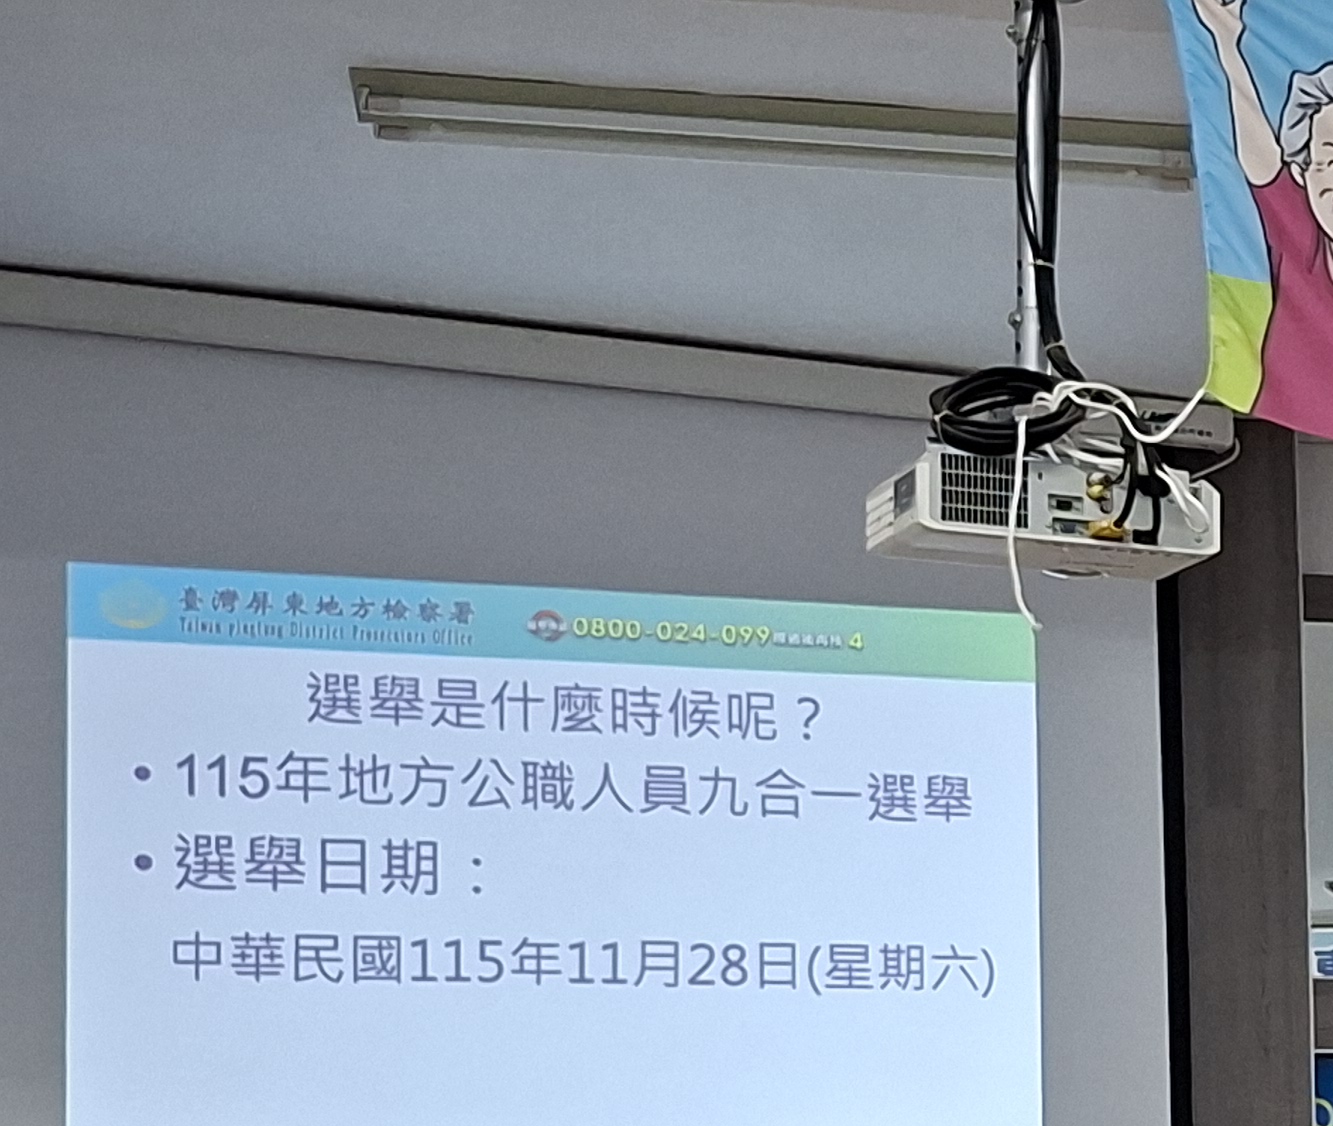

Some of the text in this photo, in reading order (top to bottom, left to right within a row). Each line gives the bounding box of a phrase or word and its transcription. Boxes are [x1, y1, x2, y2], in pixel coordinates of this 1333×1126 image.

[179, 586, 476, 625] 臺灣屏東地方檢察署
[571, 616, 771, 646] 0800-024-099
[306, 672, 822, 742] 選舉是什麼時候呢？
[175, 752, 973, 824] 115年地方公職人員九合一選舉
[174, 833, 486, 896] 選舉日期：
[172, 932, 996, 997] 中華民國115年11月28日(星期六)
